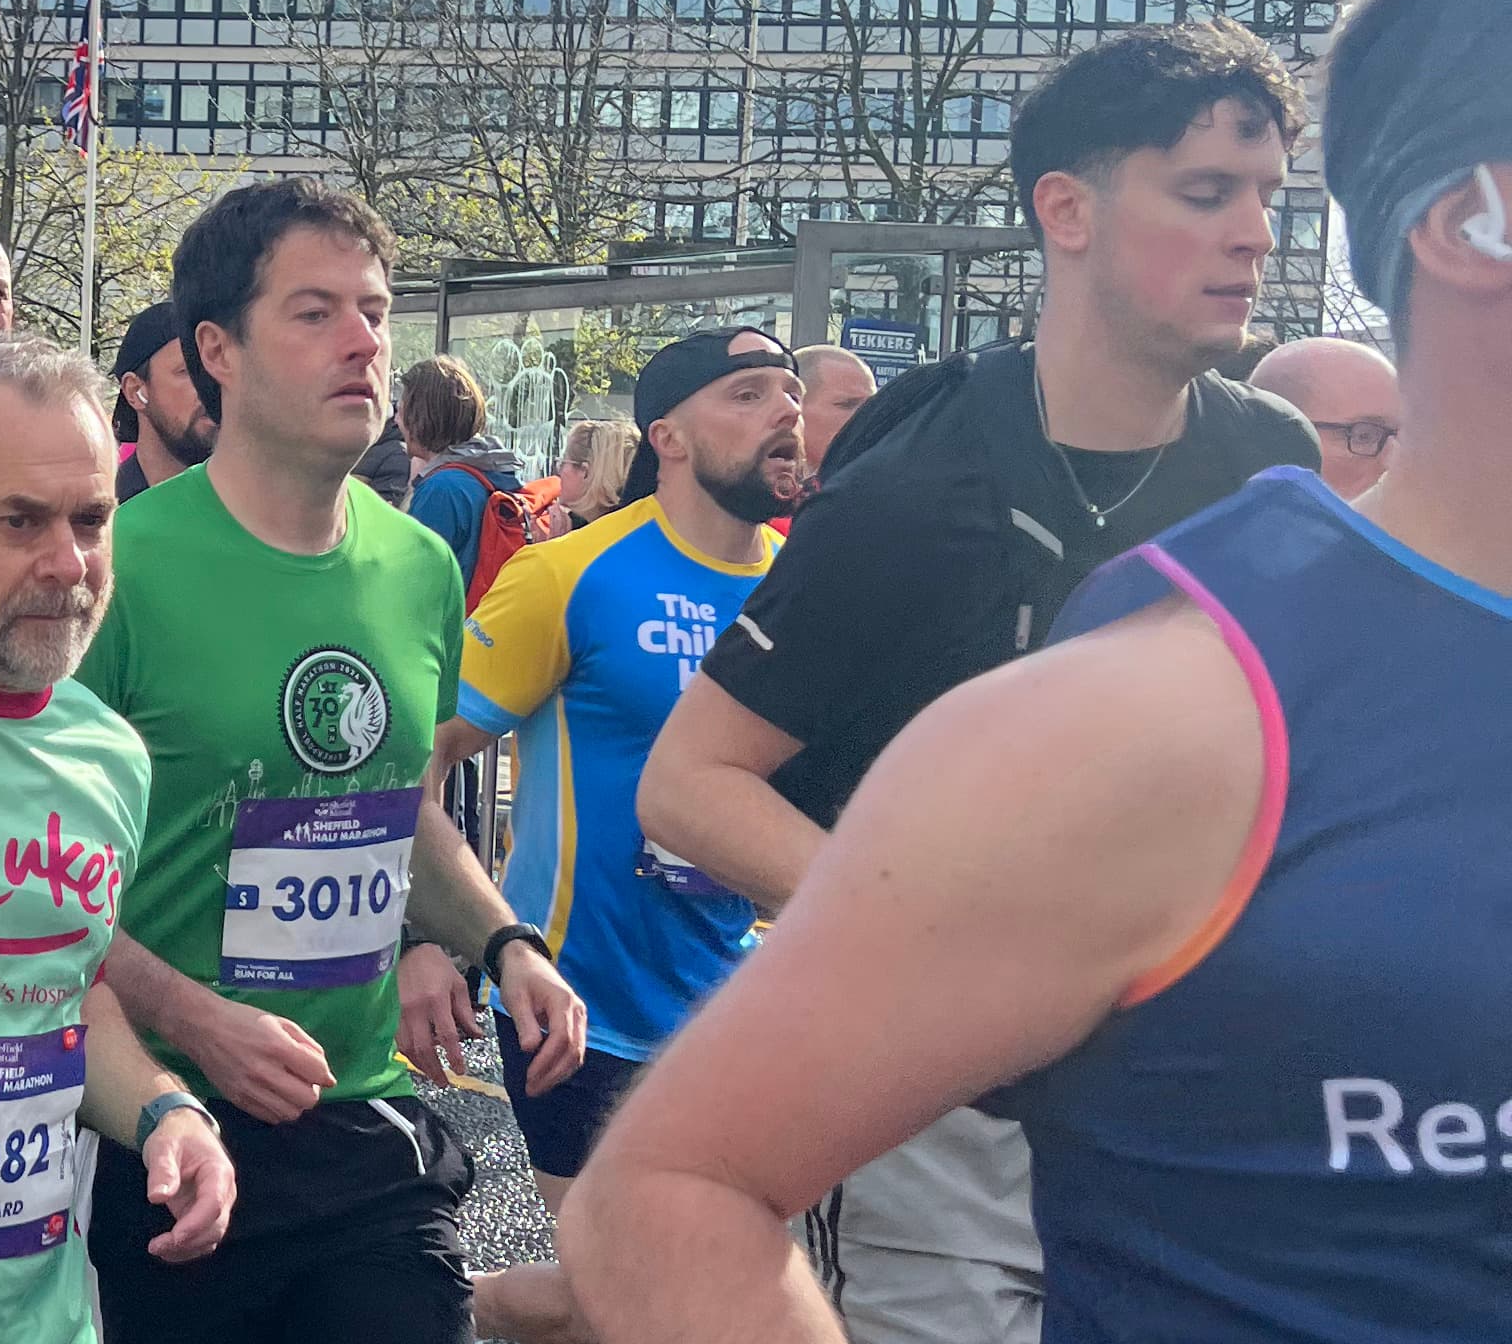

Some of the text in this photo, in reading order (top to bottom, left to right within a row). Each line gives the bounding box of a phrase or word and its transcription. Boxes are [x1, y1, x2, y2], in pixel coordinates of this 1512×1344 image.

[850, 334, 913, 350] TEKKERS
[656, 593, 716, 622] The
[313, 819, 360, 831] SHEFFIELD
[312, 831, 338, 843] HALF
[238, 891, 248, 906] S
[271, 868, 391, 922] 3010
[3, 1073, 54, 1093] MARATHON
[1322, 1077, 1512, 1174] Re
